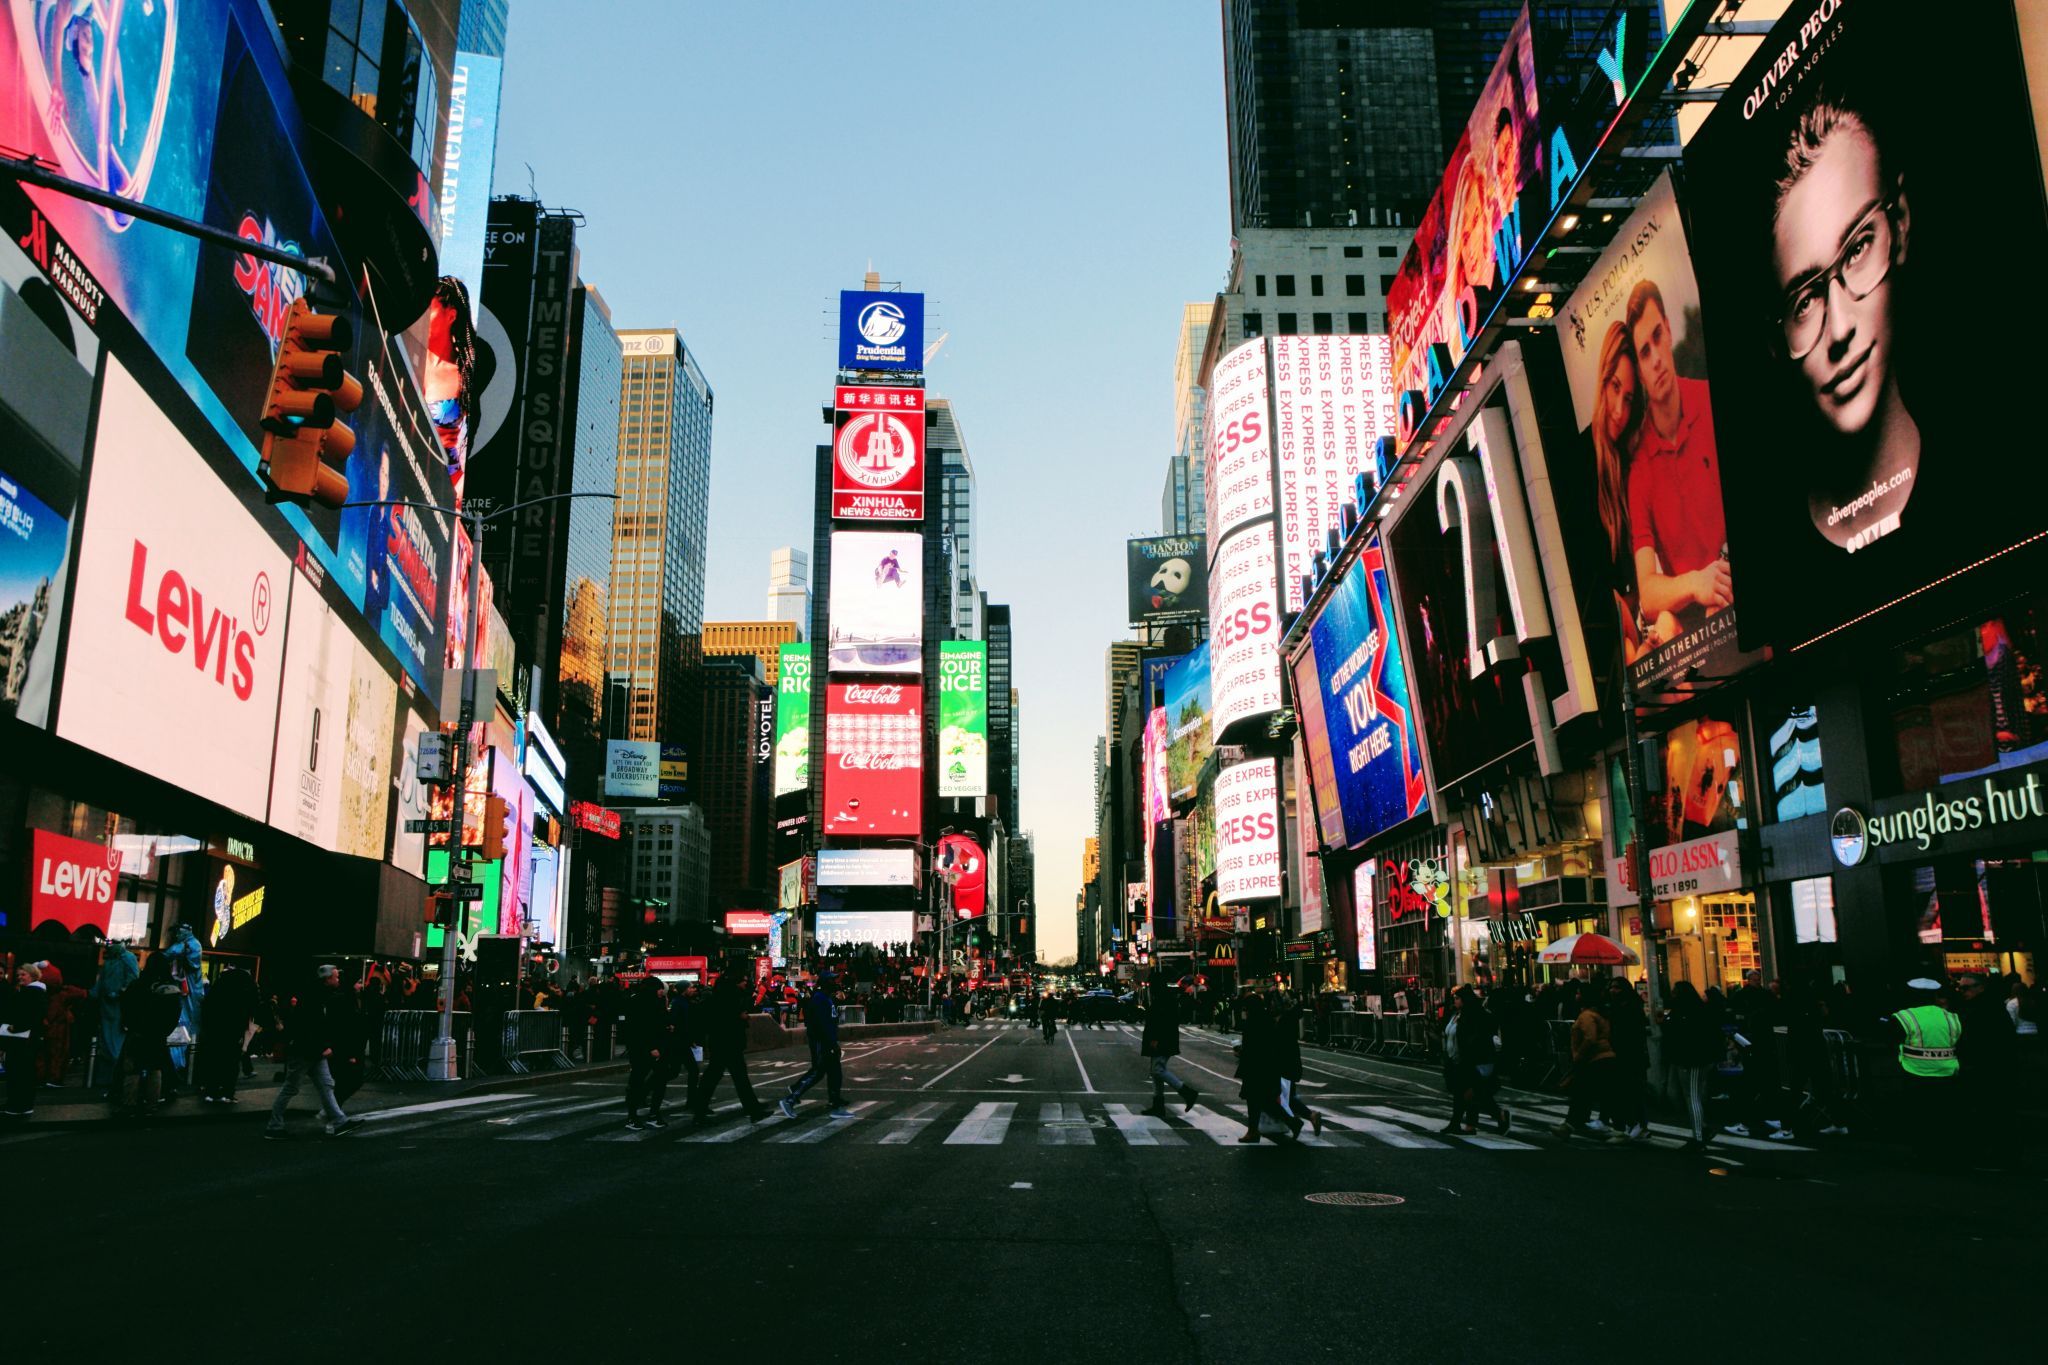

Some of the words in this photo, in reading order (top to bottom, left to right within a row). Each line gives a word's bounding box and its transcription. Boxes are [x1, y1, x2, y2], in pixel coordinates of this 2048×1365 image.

[1743, 40, 1800, 120] OLIVER
[1800, 0, 1842, 50] PEO
[1775, 84, 1792, 110] LOS
[1798, 21, 1843, 83] ANGELES
[502, 231, 526, 244] ON
[51, 261, 96, 321] MARQUIS
[55, 241, 104, 307] MARRIOTT
[1585, 290, 1603, 318] U.S.
[1602, 254, 1629, 296] POLO
[1631, 215, 1661, 262] ASSN.
[538, 250, 566, 377] TIMES
[857, 345, 906, 356] Prudential
[843, 393, 916, 406] 新华通讯社
[1280, 390, 1295, 461] EXPRESS
[1320, 390, 1336, 460] EXPRESS
[1301, 405, 1316, 476] EXPRESS
[1343, 405, 1359, 475] EXPRESS
[521, 392, 555, 557] SQUARE
[859, 471, 902, 484] XINHUA
[1827, 466, 1912, 527] oliverpeoples.com
[840, 508, 871, 517] NEWS
[873, 508, 917, 518] AGENCY
[852, 496, 905, 508] XINHUA
[1284, 470, 1299, 543] EXPRESS
[1142, 541, 1199, 554] PHANTOM
[126, 538, 255, 702] Levi's
[1331, 672, 1342, 695] LET
[1340, 661, 1351, 686] THE
[1349, 642, 1369, 677] WORLD
[1366, 628, 1380, 656] SEE
[1635, 658, 1656, 679] LIVE
[844, 684, 904, 704] Coca-Cola
[1344, 672, 1377, 735] YOU
[758, 694, 773, 764] NOVOTEL
[1173, 716, 1204, 741] Conservation
[1348, 736, 1371, 774] RIGHT
[1369, 722, 1392, 759] HERE
[301, 773, 322, 799] CLINIQUE
[617, 766, 648, 774] BROADWAY
[415, 822, 424, 833] W
[427, 822, 439, 833] 45
[1868, 792, 1983, 851] sunglass
[1985, 773, 2045, 824] hut
[227, 837, 254, 862] INVICTA
[1649, 850, 1678, 879] OLO
[1681, 842, 1724, 873] ASSN.
[40, 858, 112, 904] Levi's
[1652, 882, 1669, 896] NCE
[1672, 879, 1698, 893] 1890
[1524, 912, 1540, 939] 21
